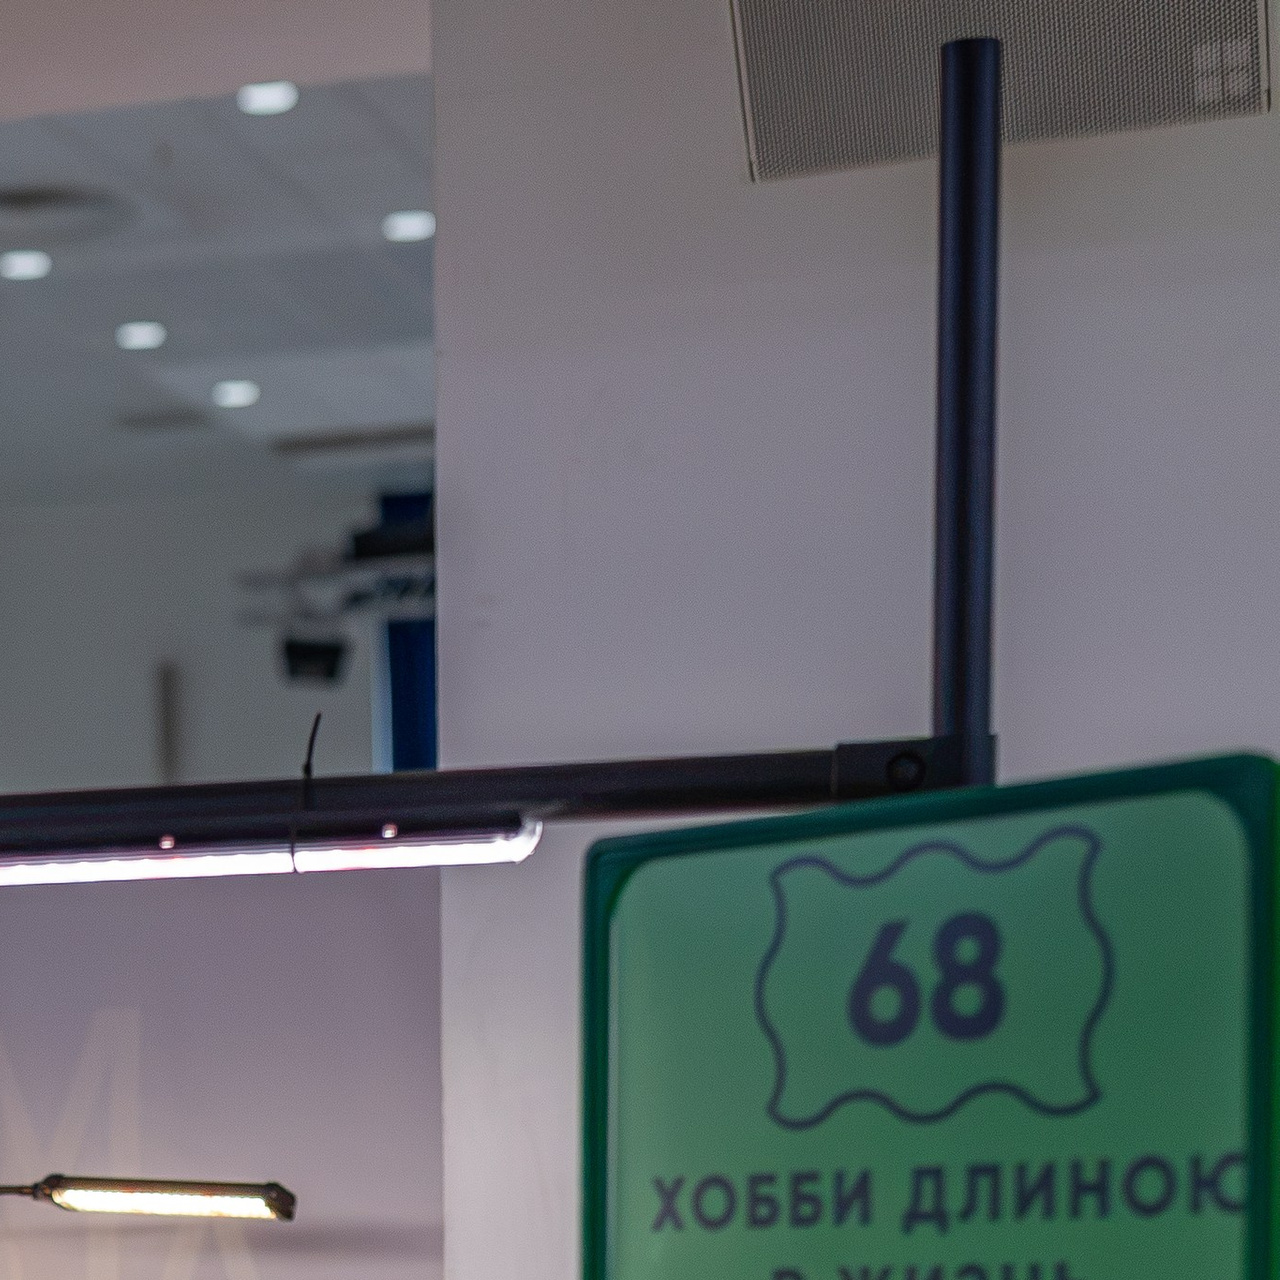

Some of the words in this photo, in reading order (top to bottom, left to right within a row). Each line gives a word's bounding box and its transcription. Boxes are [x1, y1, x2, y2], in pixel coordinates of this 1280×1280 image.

[848, 911, 1006, 1045] 68
[652, 1168, 872, 1233] ХОББИ
[903, 1150, 1246, 1234] ДЛИНОЮ
